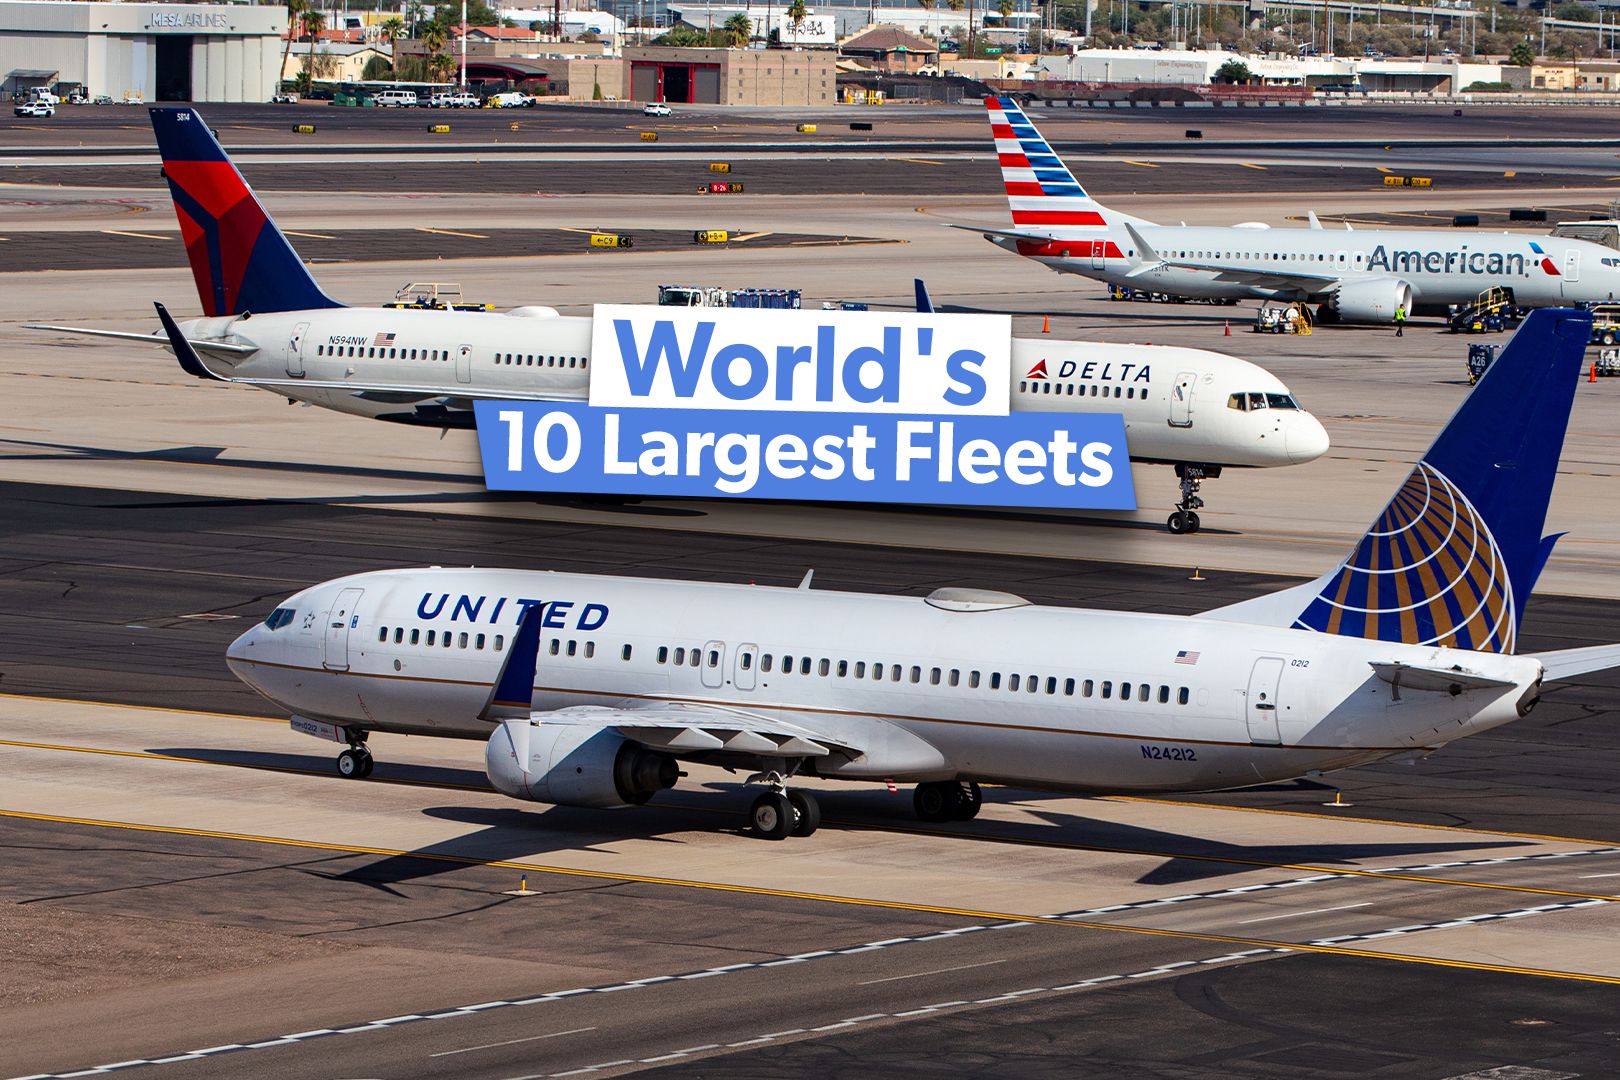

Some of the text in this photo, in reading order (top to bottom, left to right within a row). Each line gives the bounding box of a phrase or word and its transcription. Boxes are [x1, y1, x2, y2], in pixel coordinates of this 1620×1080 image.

[152, 12, 227, 28] MESA AIRLINES
[1367, 243, 1525, 276] American
[328, 335, 368, 346] N594NW
[1471, 356, 1486, 367] A26
[1059, 360, 1151, 383] DELTA
[417, 592, 610, 632] UNITED
[1291, 659, 1310, 668] 0212
[1141, 745, 1197, 762] N24212
